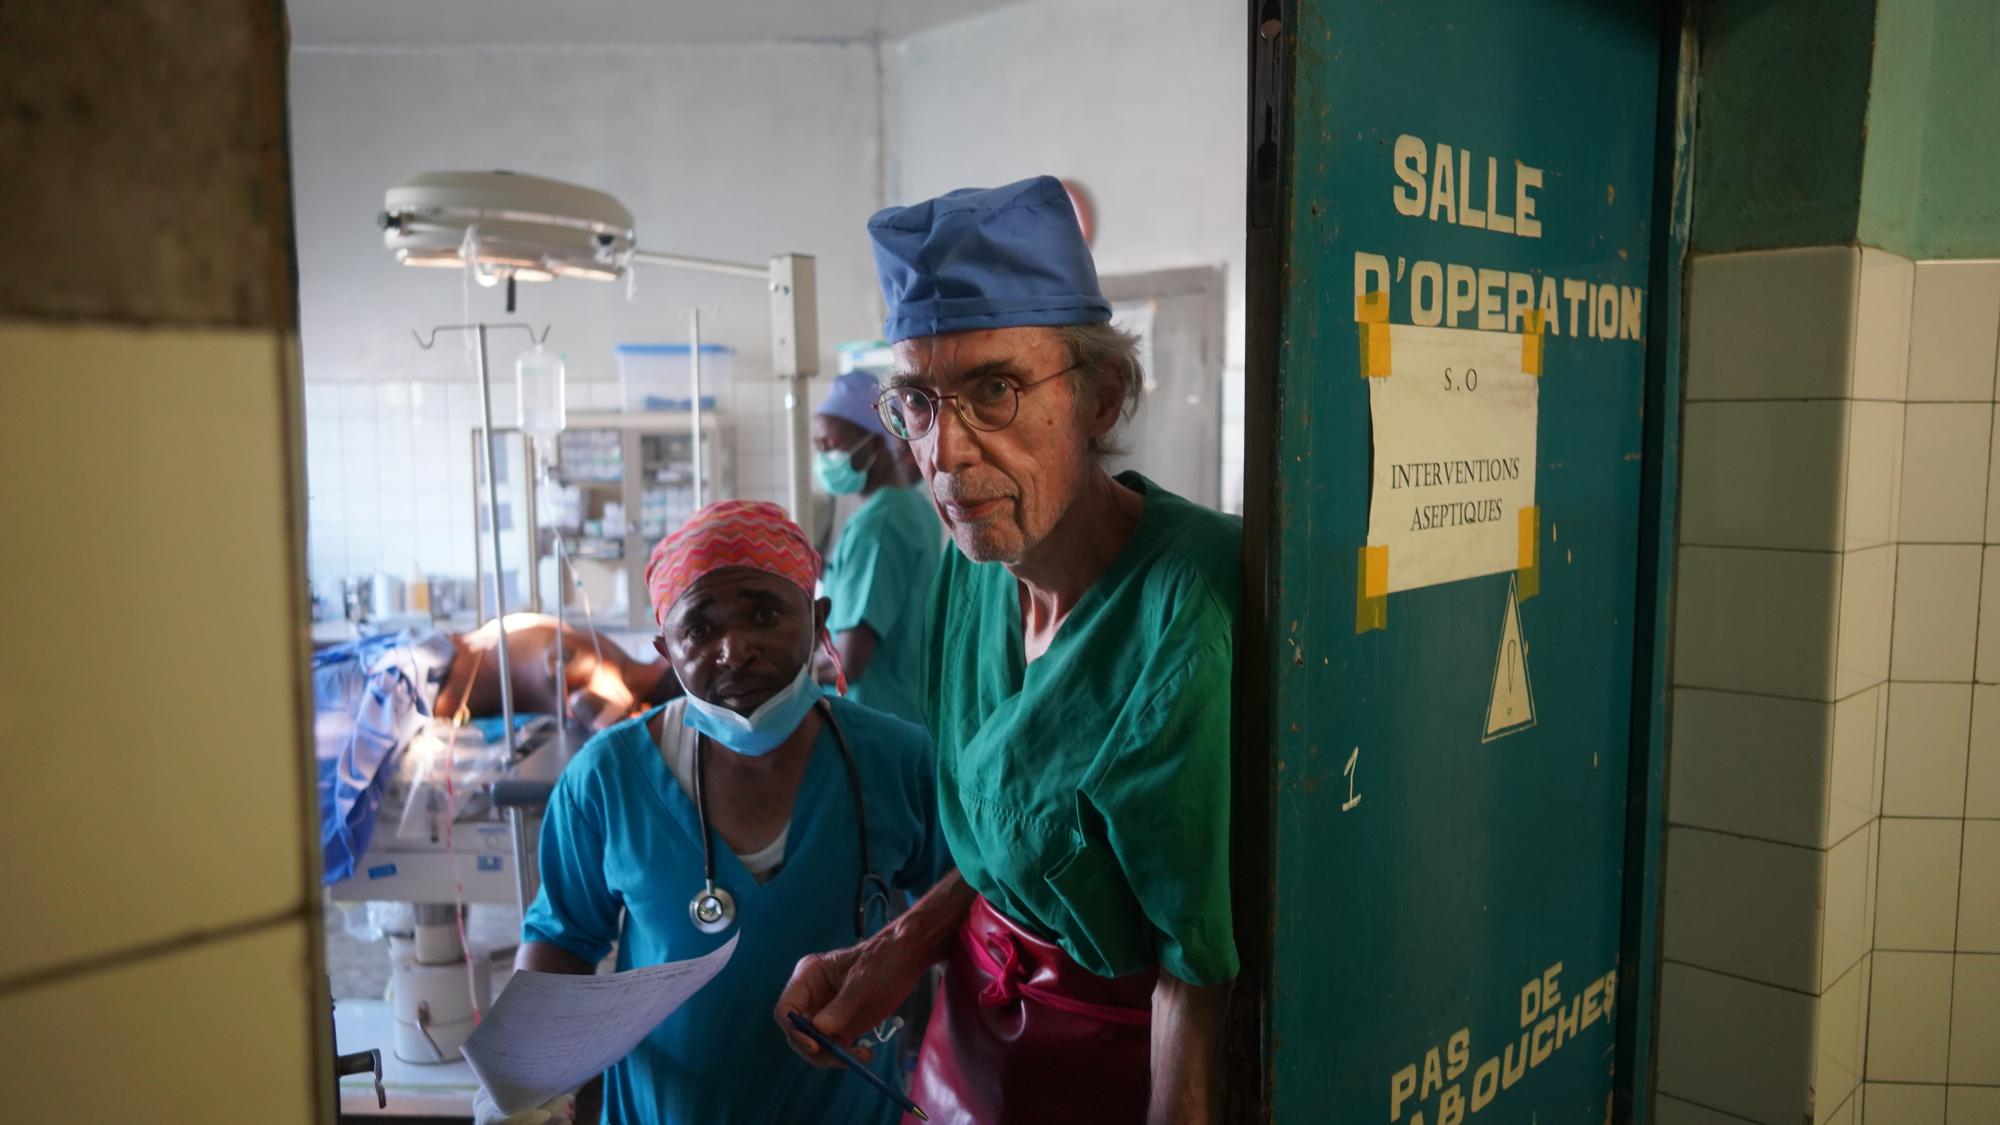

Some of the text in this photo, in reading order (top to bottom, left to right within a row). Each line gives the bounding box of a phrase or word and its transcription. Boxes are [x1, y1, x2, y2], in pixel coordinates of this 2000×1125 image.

[1393, 133, 1543, 238] SALLE
[1354, 251, 1643, 341] D'OPERATION
[1390, 457, 1520, 490] INTERVENTIONS
[1409, 498, 1503, 532] ASEPTIQUES
[1342, 746, 1362, 811] 1
[1390, 960, 1563, 1122] PAS DE
